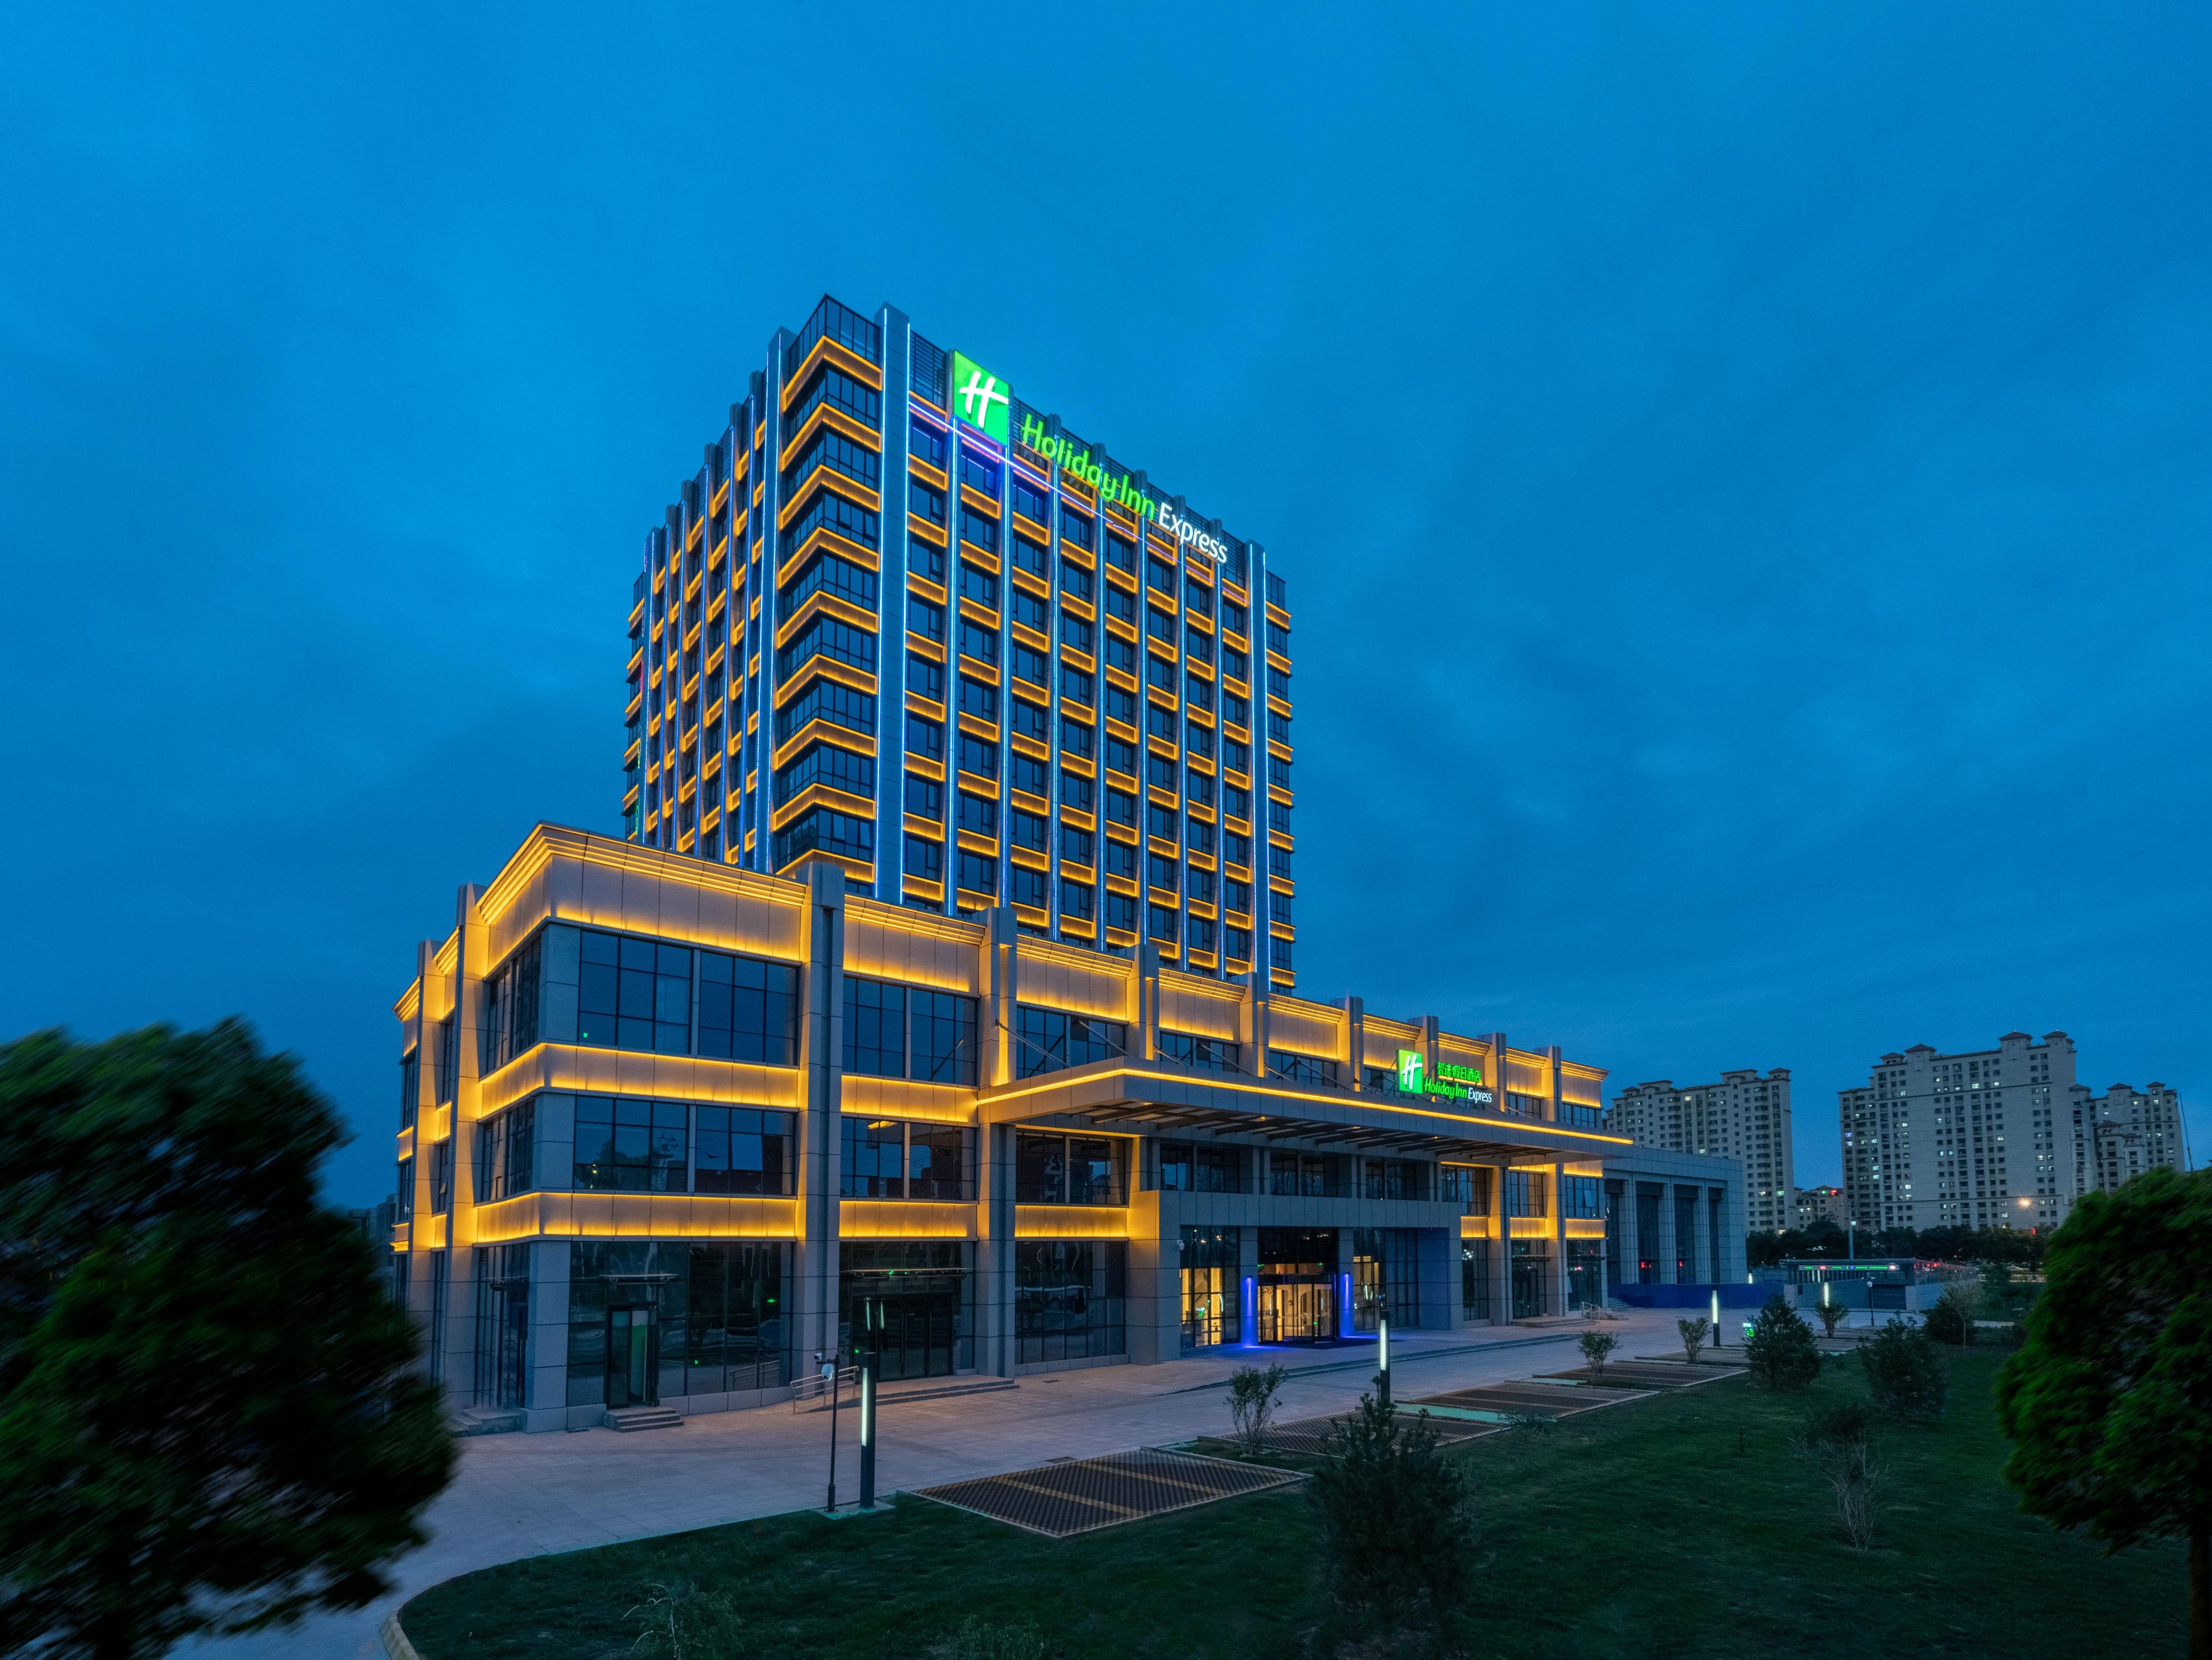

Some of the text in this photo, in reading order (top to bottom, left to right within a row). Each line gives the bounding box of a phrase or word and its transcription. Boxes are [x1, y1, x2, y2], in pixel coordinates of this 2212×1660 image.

[1021, 413, 1228, 563] Holiday Inn Express
[1437, 1061, 1481, 1083] 智选假日酒店
[1425, 1077, 1492, 1104] Holiday Inn Express
